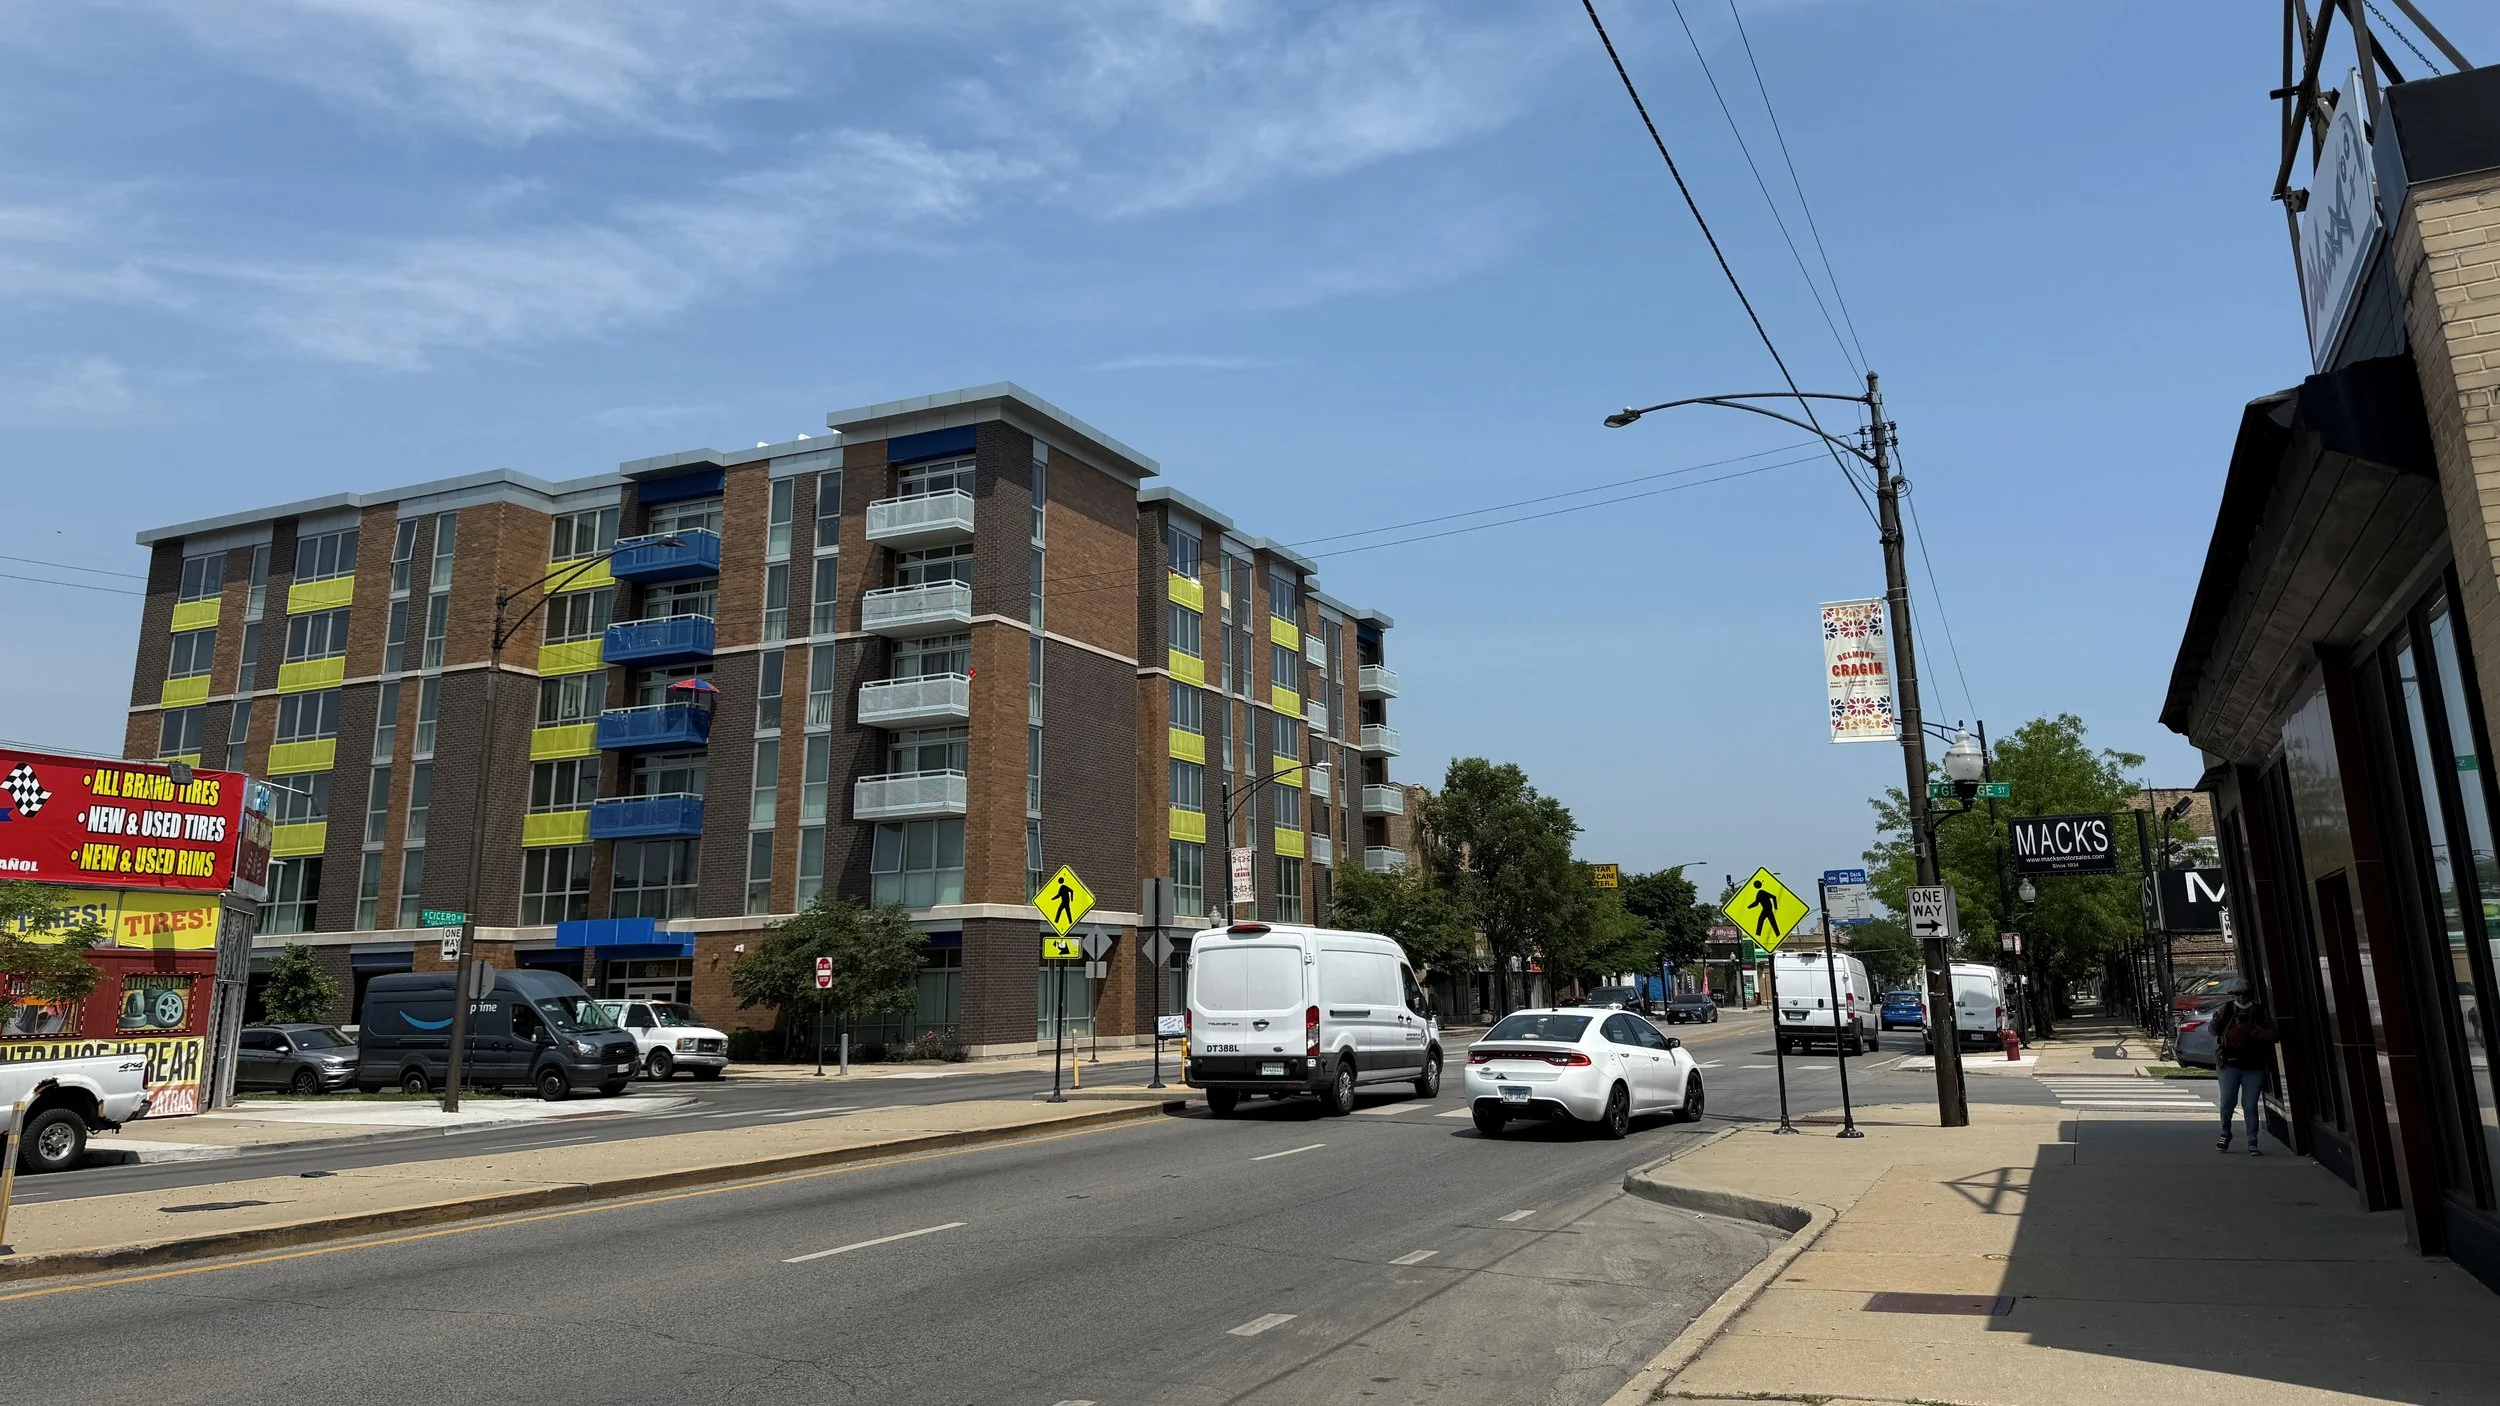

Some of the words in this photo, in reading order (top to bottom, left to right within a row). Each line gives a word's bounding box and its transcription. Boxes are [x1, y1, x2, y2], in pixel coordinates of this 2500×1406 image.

[1837, 651, 1875, 662] BELMONT
[1832, 662, 1884, 678] CRAGIN
[92, 769, 119, 796] ALL
[121, 773, 174, 802] BRAND
[178, 781, 220, 807] TIRES
[1941, 785, 1994, 797] GEGE
[87, 805, 126, 835] NEW
[126, 813, 139, 836] &
[141, 810, 181, 840] USED
[184, 813, 226, 843] TIRES
[2015, 819, 2109, 856] MACK'S
[80, 843, 119, 872] NEW
[119, 849, 132, 873] &
[135, 847, 174, 876] USED
[176, 850, 216, 878] RIMS
[1912, 890, 1942, 903] ONE
[428, 911, 457, 921] CICERO
[1913, 904, 1942, 917] WAY
[124, 907, 212, 938] TIRES!
[445, 929, 461, 938] ONE
[444, 938, 460, 948] WAY
[1206, 1044, 1240, 1053] DT388L
[145, 1041, 199, 1083] REAR
[154, 1088, 194, 1113] ATRAS
